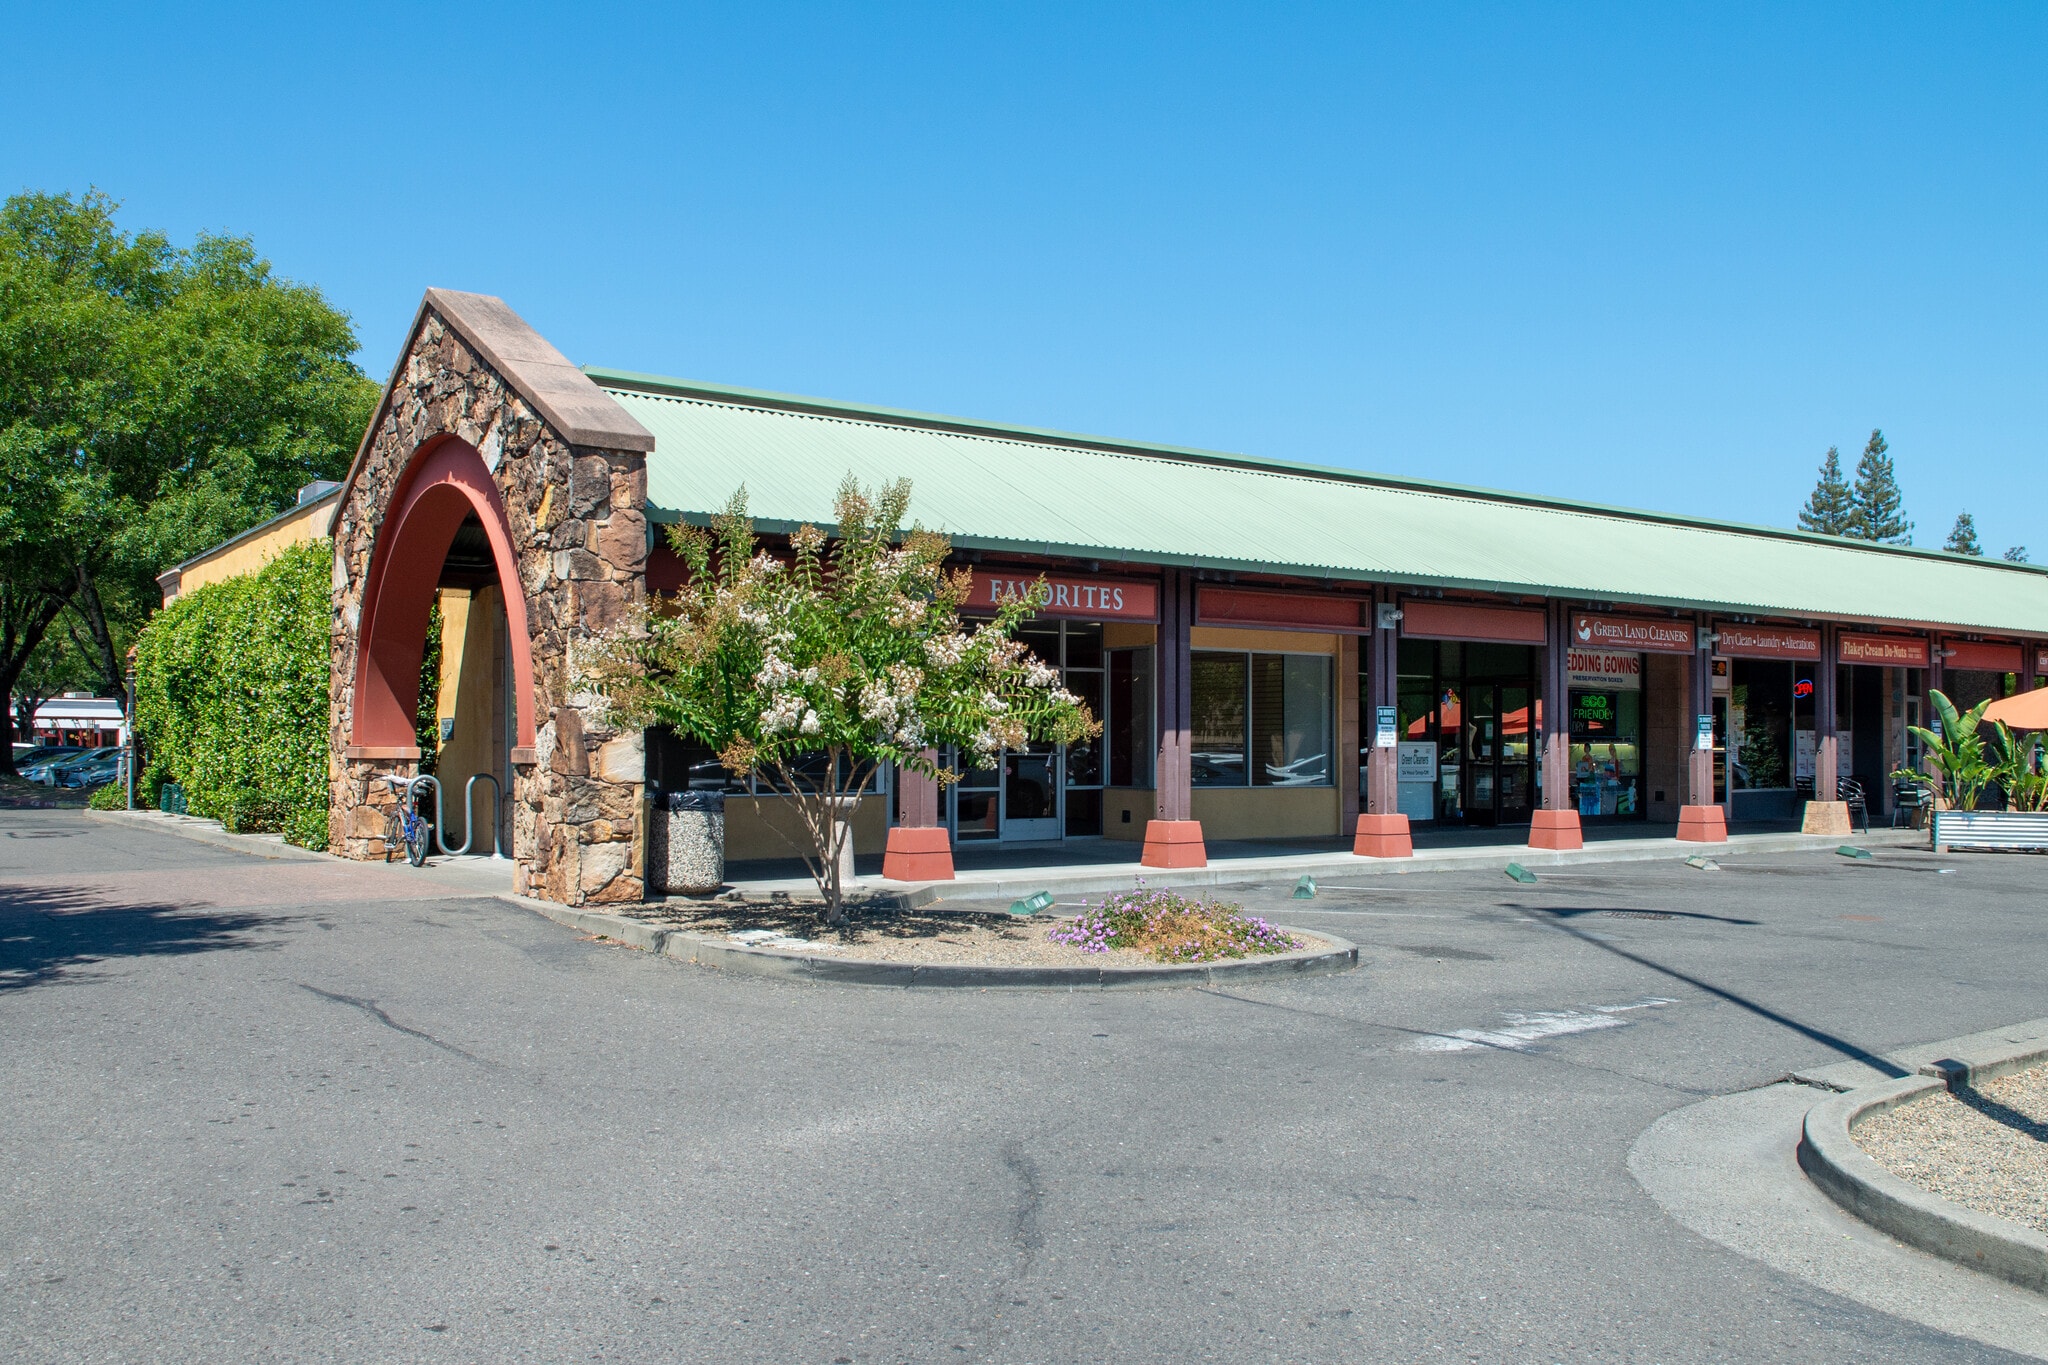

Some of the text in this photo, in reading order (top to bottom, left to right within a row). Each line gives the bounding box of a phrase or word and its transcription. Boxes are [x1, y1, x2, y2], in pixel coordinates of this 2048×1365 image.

[990, 579, 1123, 610] FAVORITES
[1594, 621, 1688, 642] GREEN LAND CLEANERS
[1722, 632, 1816, 651] Dry Clean Laundry Alterations
[1844, 642, 1864, 658] Flakey
[1865, 643, 1883, 657] Cream
[1885, 644, 1907, 658] Do-Nuts
[1567, 653, 1640, 674] EDDING GOWNS
[1794, 683, 1813, 695] OPEN
[1581, 695, 1607, 707] ECO
[1573, 708, 1614, 720] FRIENDLY
